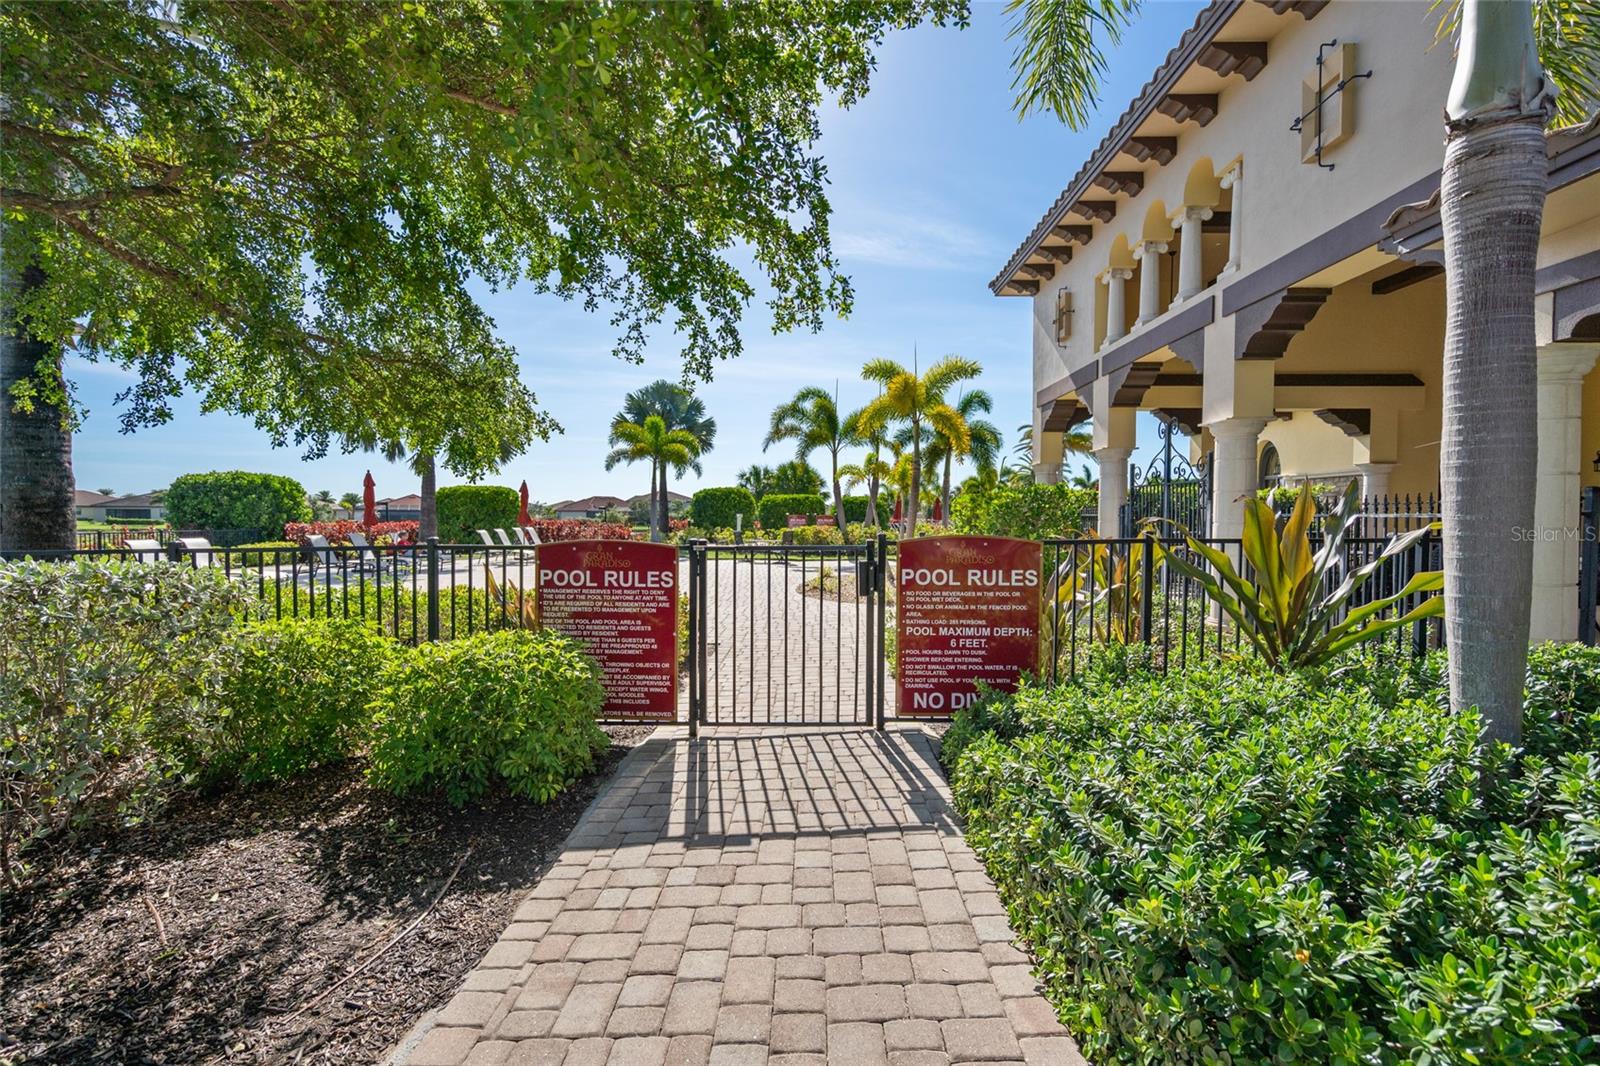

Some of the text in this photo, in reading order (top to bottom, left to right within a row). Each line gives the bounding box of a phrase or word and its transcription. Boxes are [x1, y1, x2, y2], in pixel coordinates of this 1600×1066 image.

[585, 552, 614, 560] GRAN
[583, 560, 631, 568] PARADISO
[540, 570, 674, 588] POOL RULES
[902, 569, 1038, 586] POOL RULES
[906, 627, 1033, 636] POOL MAXIMUM DEPTH:
[950, 639, 988, 648] 6 FEET.
[914, 692, 944, 709] NO
